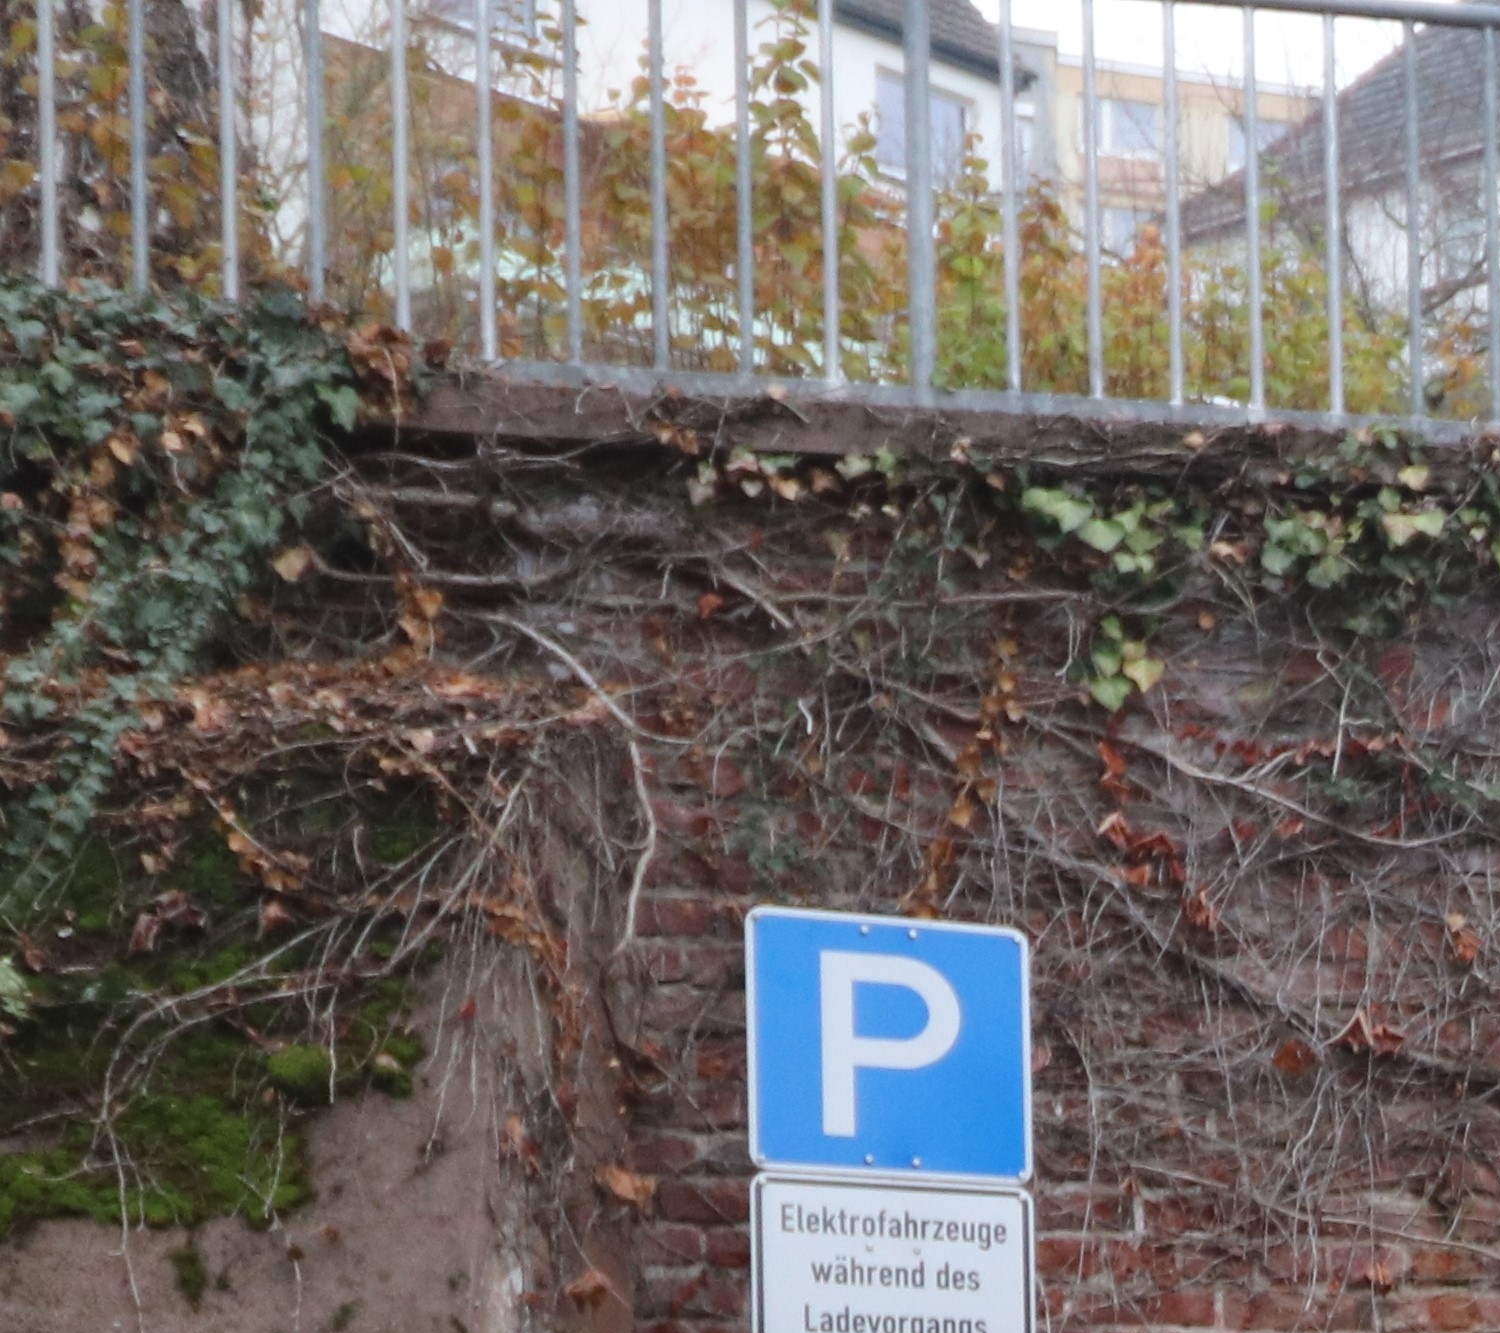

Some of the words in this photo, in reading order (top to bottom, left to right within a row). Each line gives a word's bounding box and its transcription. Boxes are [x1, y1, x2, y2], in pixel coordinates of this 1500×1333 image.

[819, 949, 963, 1138] P
[780, 1203, 1008, 1251] Elektrofahrzeuge
[811, 1255, 926, 1290] während
[936, 1262, 981, 1292] des
